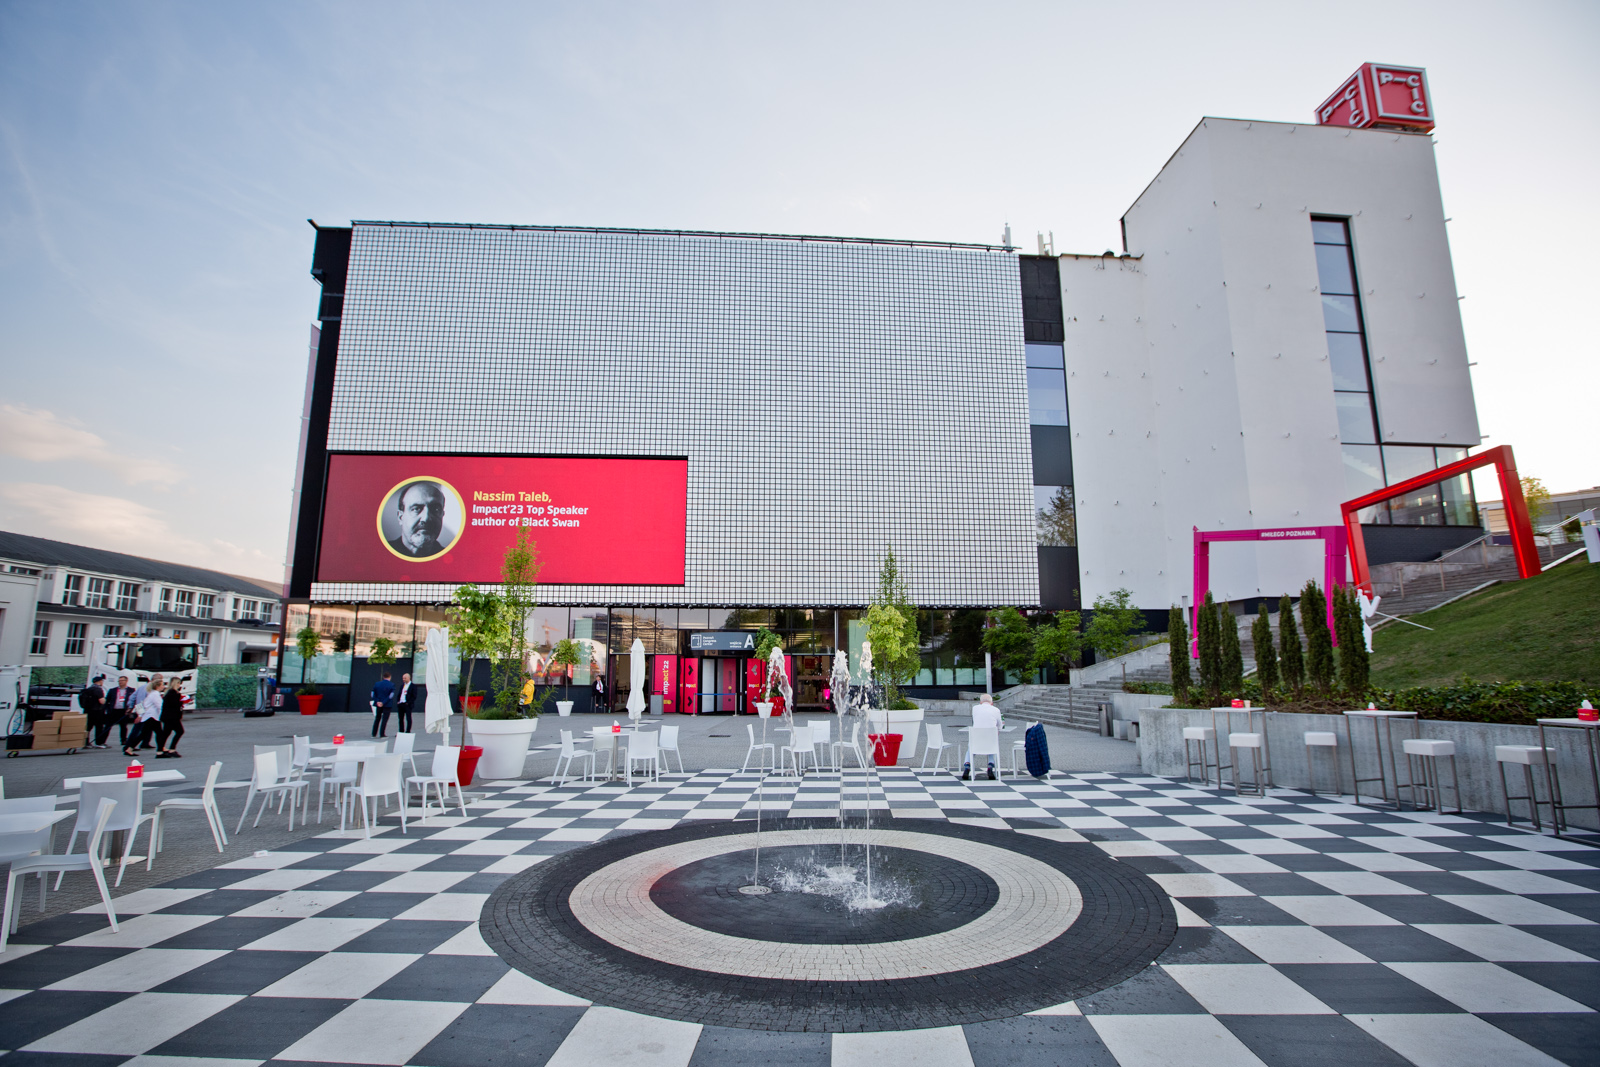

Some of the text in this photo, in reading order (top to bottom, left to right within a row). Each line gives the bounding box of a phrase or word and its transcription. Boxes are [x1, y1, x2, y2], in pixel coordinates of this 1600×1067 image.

[473, 490, 552, 503] Nassim Taleb,
[472, 504, 589, 516] Impact'23 Top Speaker
[471, 516, 580, 528] author of Black Swan
[743, 634, 755, 649] A
